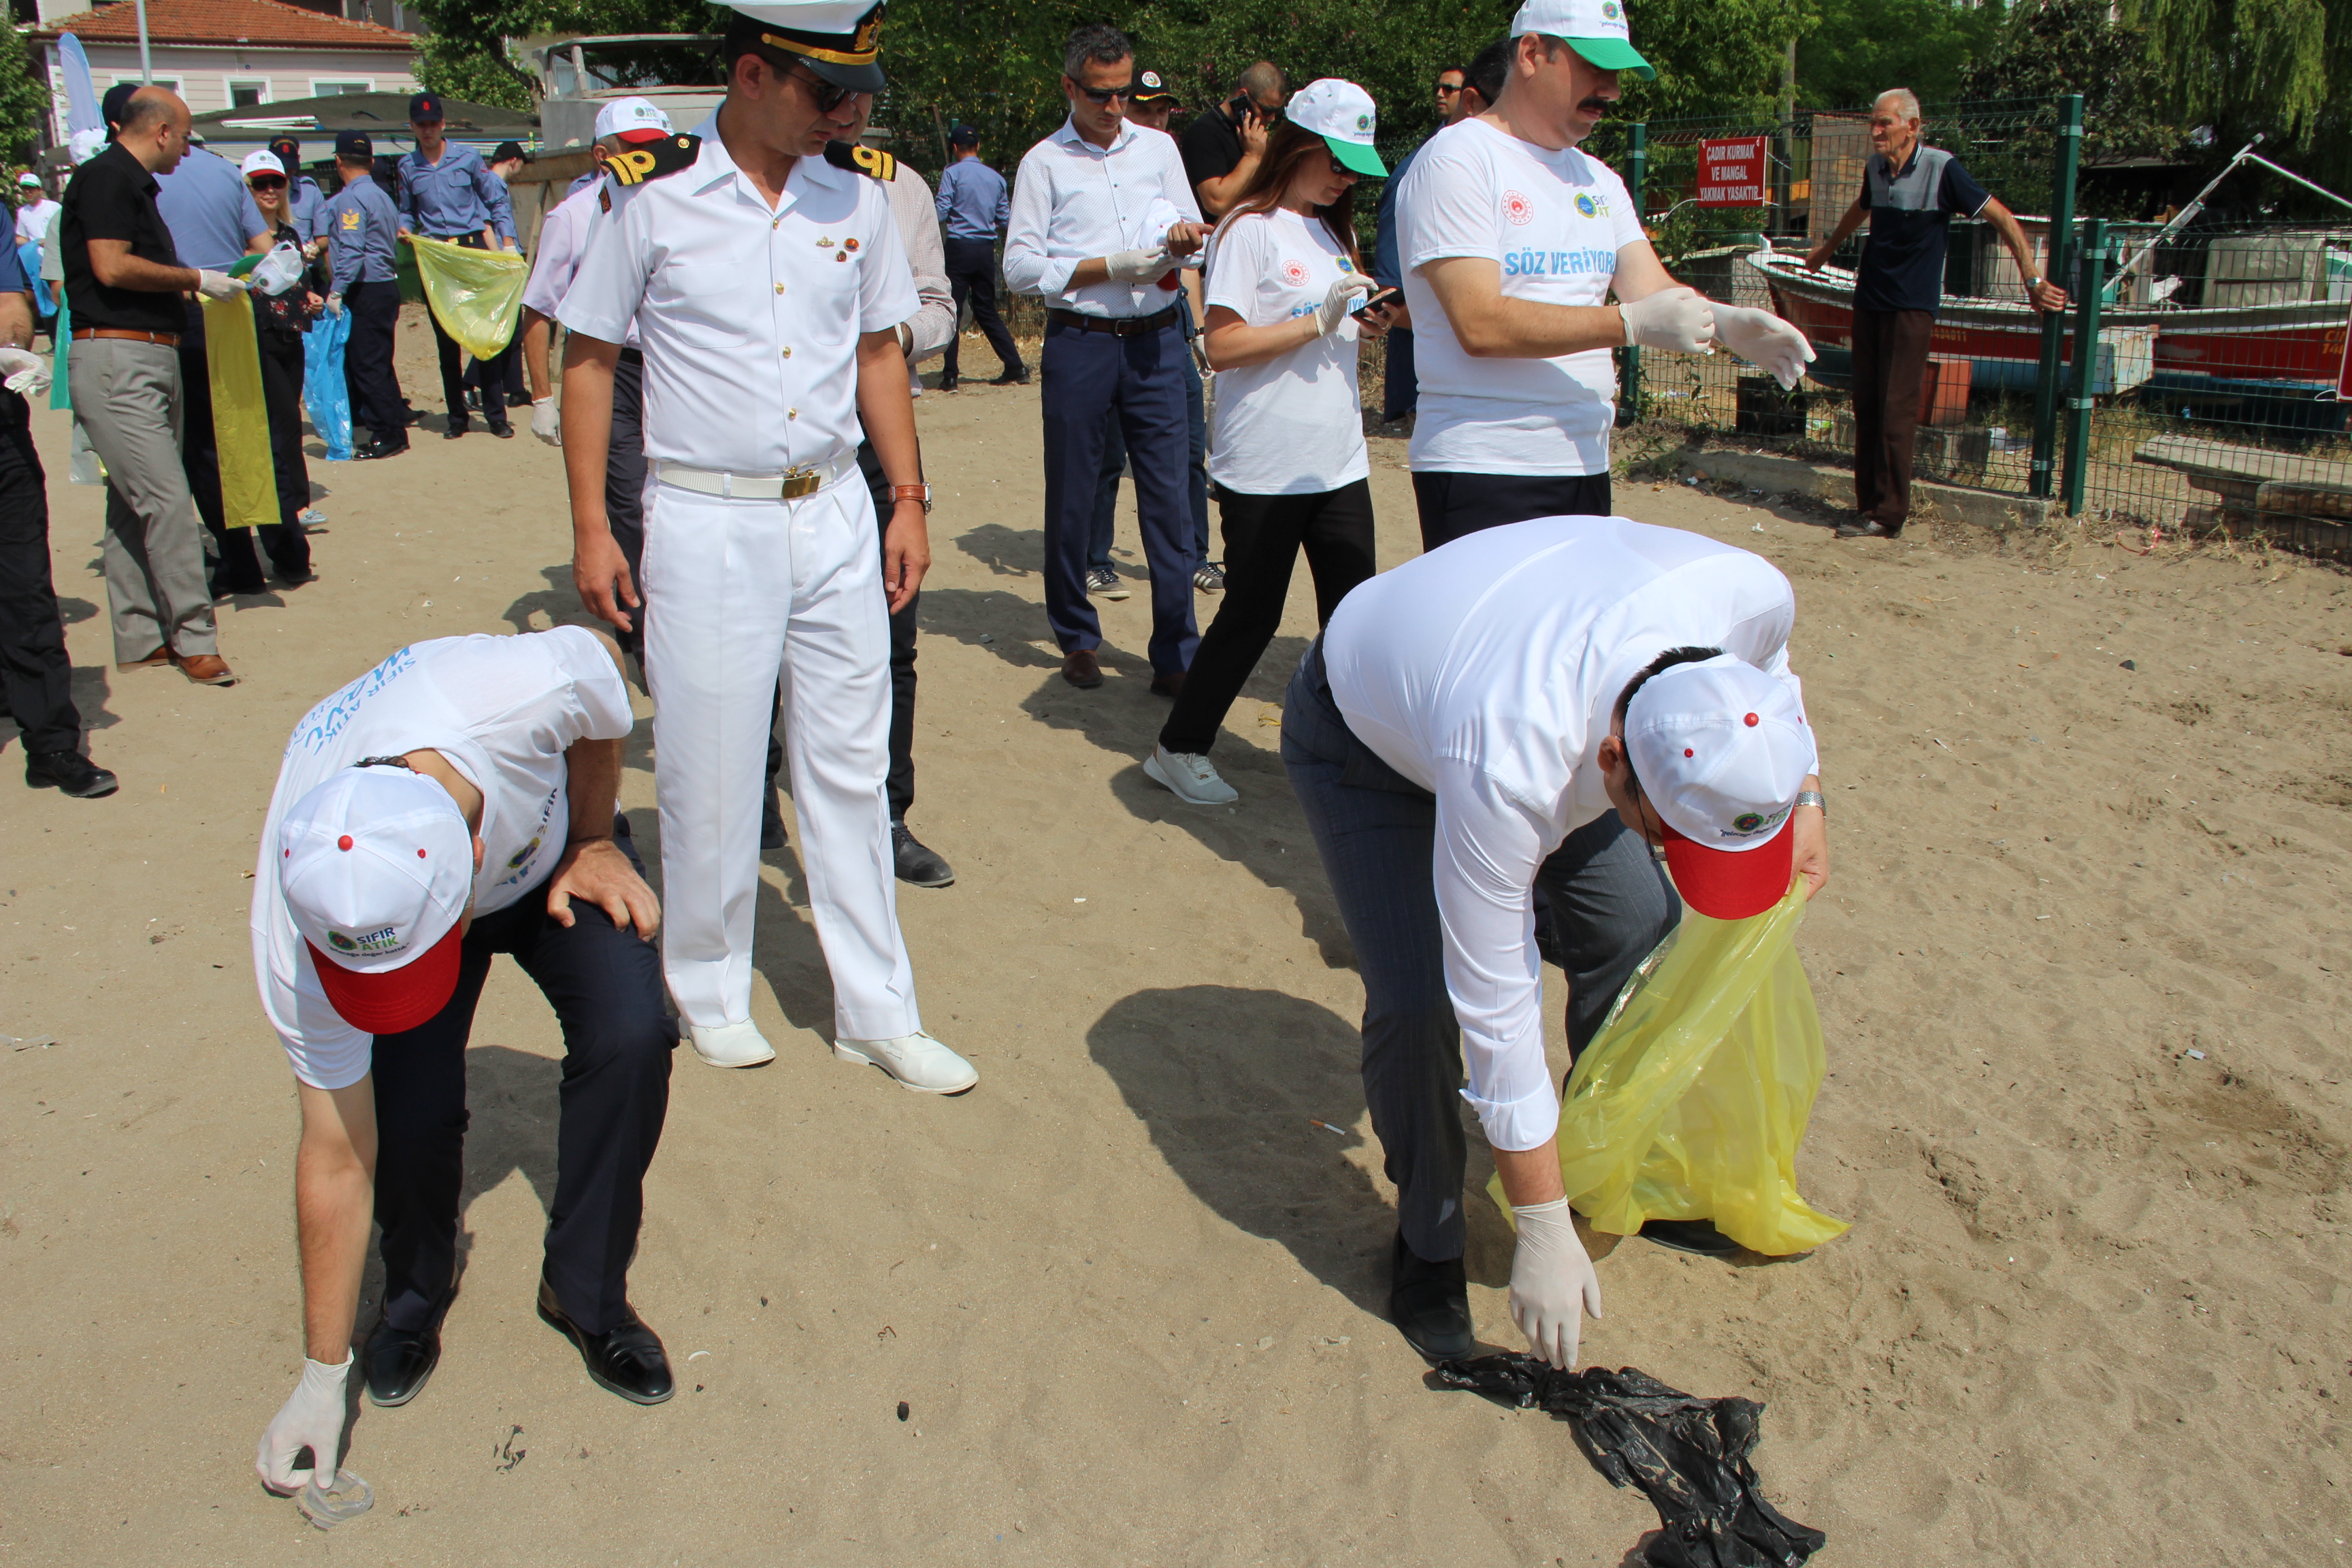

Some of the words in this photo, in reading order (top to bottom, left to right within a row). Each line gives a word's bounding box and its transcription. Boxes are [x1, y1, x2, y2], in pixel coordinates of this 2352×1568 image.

[1706, 146, 1726, 165] ÇADIR
[1727, 144, 1755, 160] KURMAK
[1712, 167, 1720, 181] VE
[1720, 165, 1748, 181] MANGAL
[1699, 187, 1726, 201] YAKMAK
[1727, 185, 1759, 201] YASAKTIR
[1505, 246, 1546, 276] SÖZ
[367, 657, 416, 698] SIFIR
[324, 698, 361, 744] ATIK
[356, 926, 396, 945] SIFIR
[362, 935, 399, 951] ATIK
